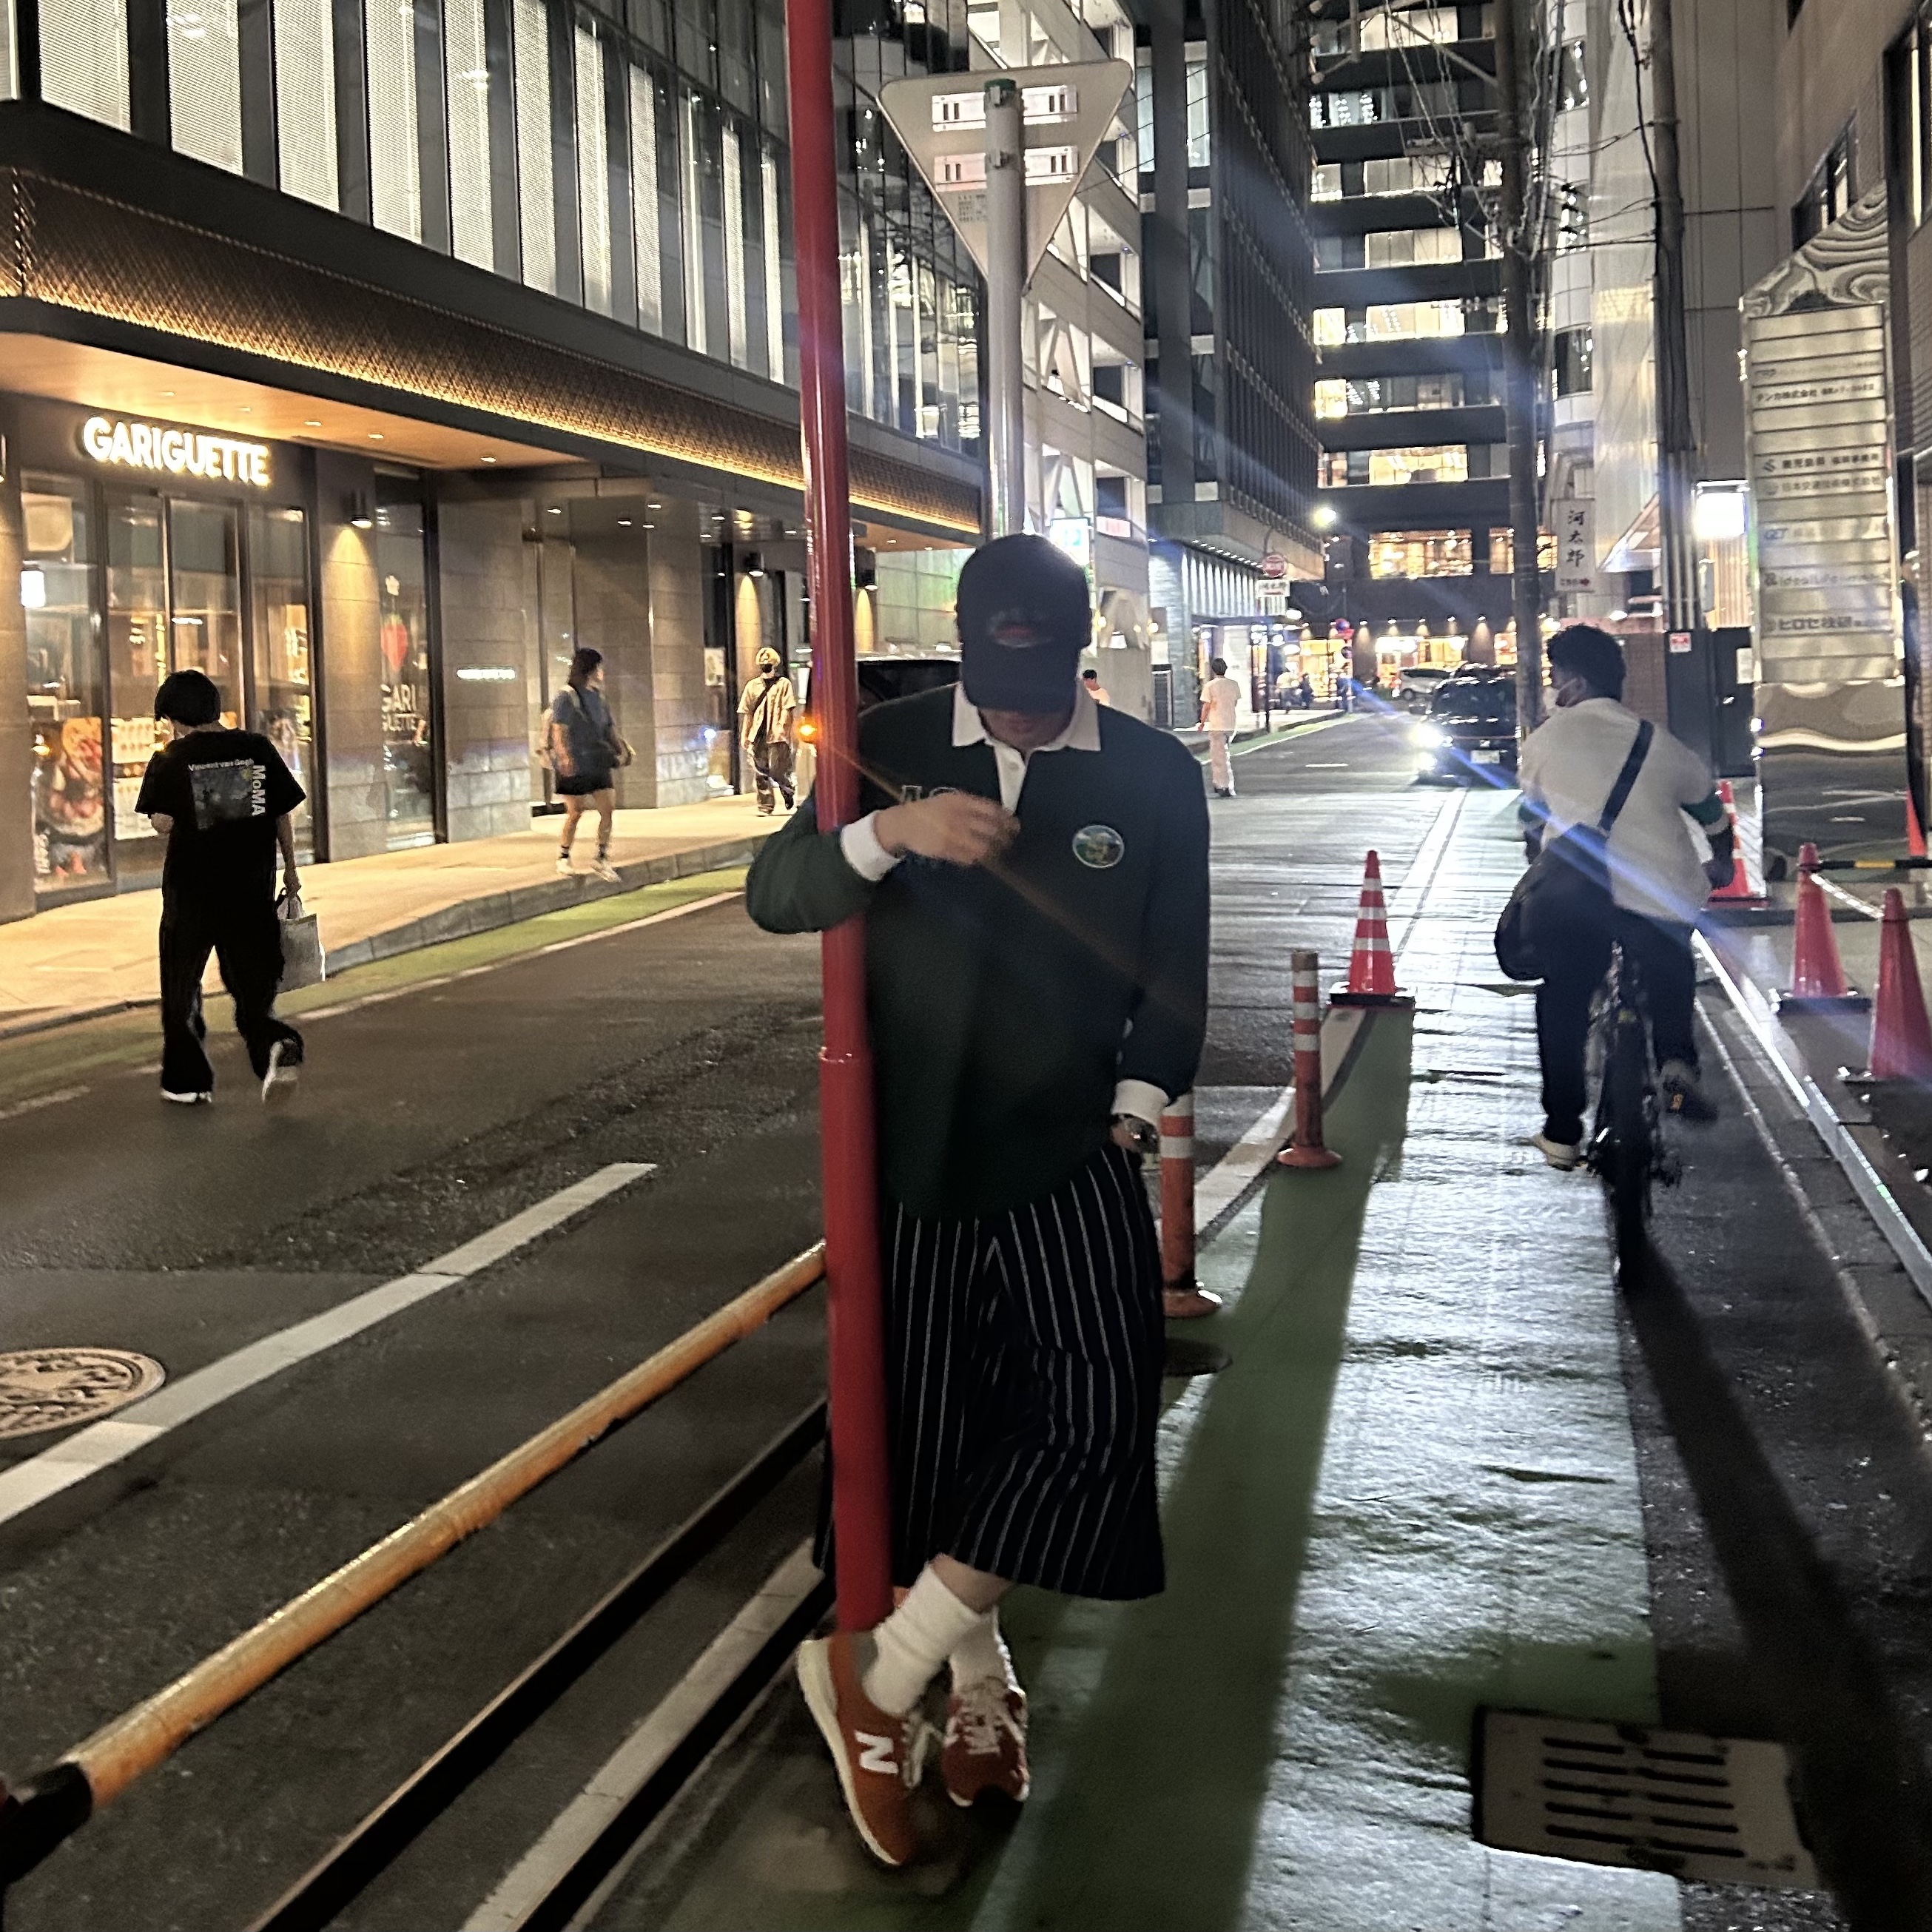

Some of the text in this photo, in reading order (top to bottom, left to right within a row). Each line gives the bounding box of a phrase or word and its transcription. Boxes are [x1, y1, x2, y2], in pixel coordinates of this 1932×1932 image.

[82, 416, 272, 487] GARIGUETTE
[252, 765, 266, 816] MoMA
[855, 1730, 898, 1775] N
